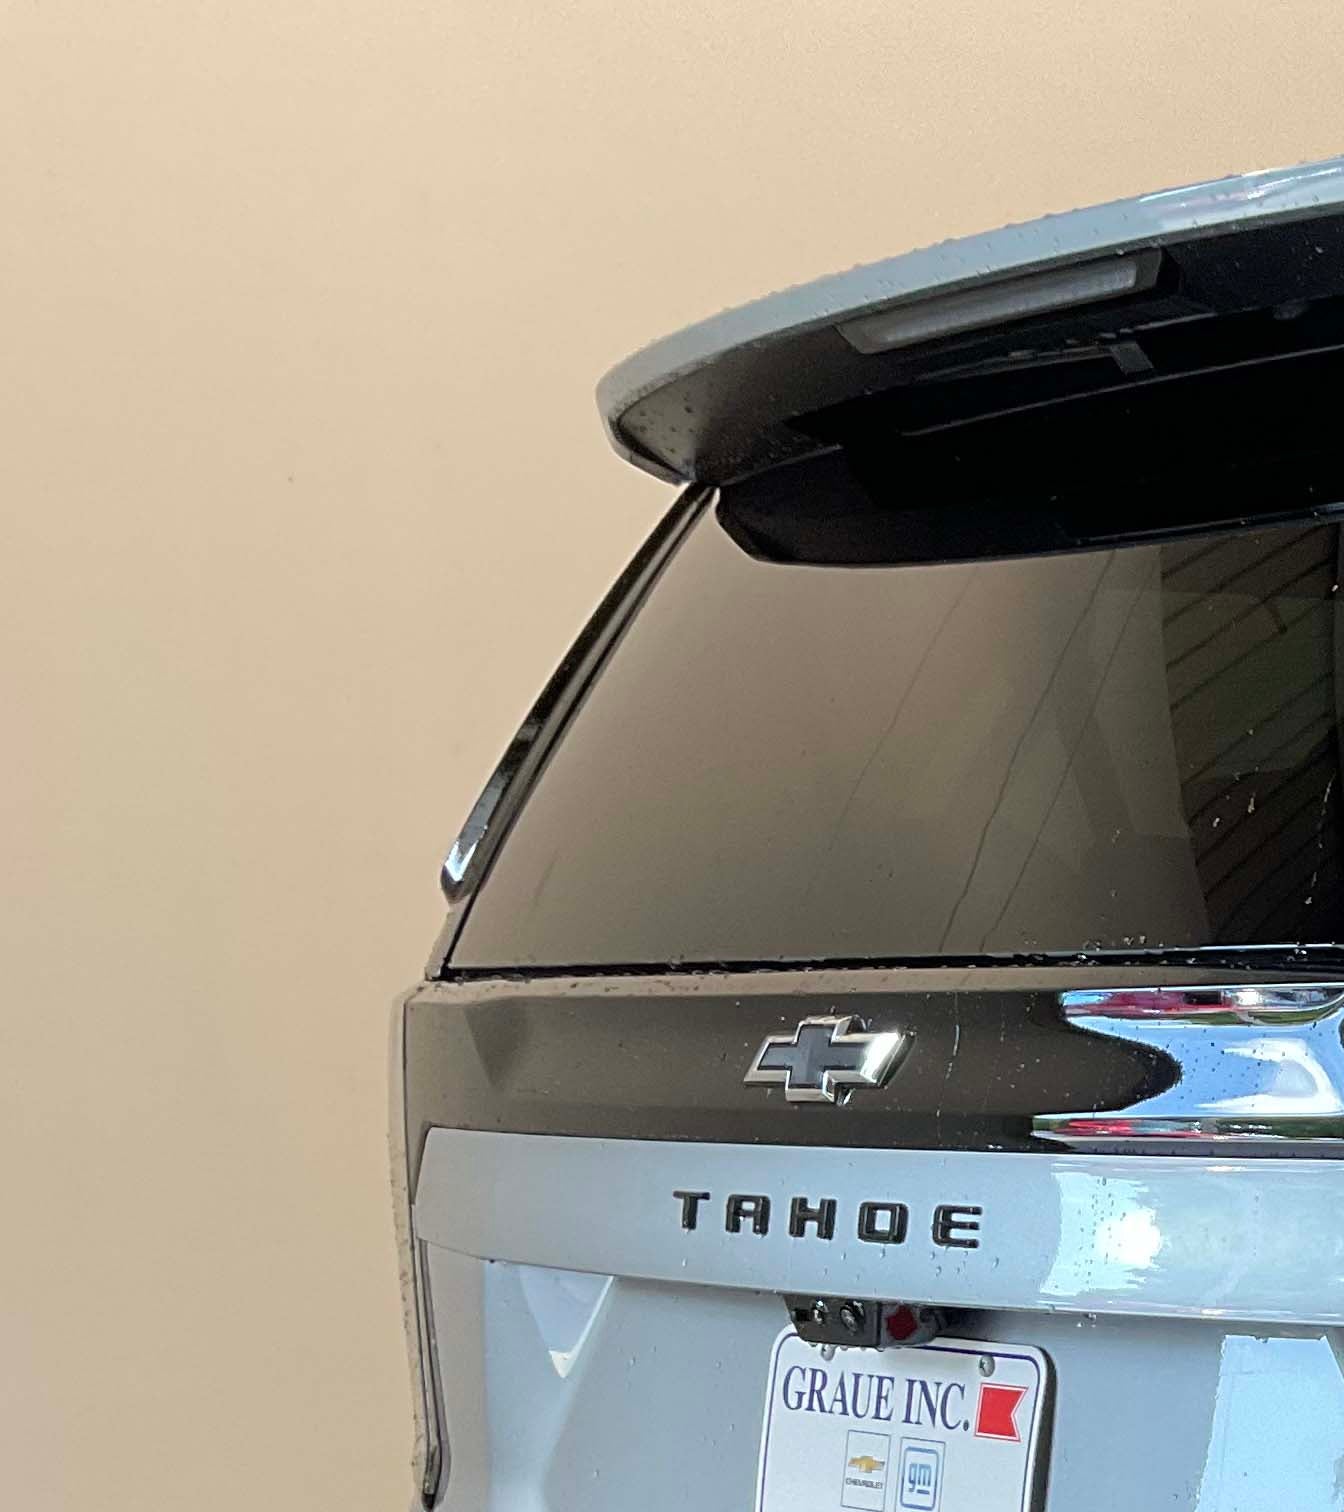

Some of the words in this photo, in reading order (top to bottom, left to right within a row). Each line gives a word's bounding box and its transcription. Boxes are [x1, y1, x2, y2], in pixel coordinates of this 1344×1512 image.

[672, 1190, 984, 1249] TAHOE
[782, 1365, 895, 1422] GRAUE
[902, 1378, 970, 1432] INC.
